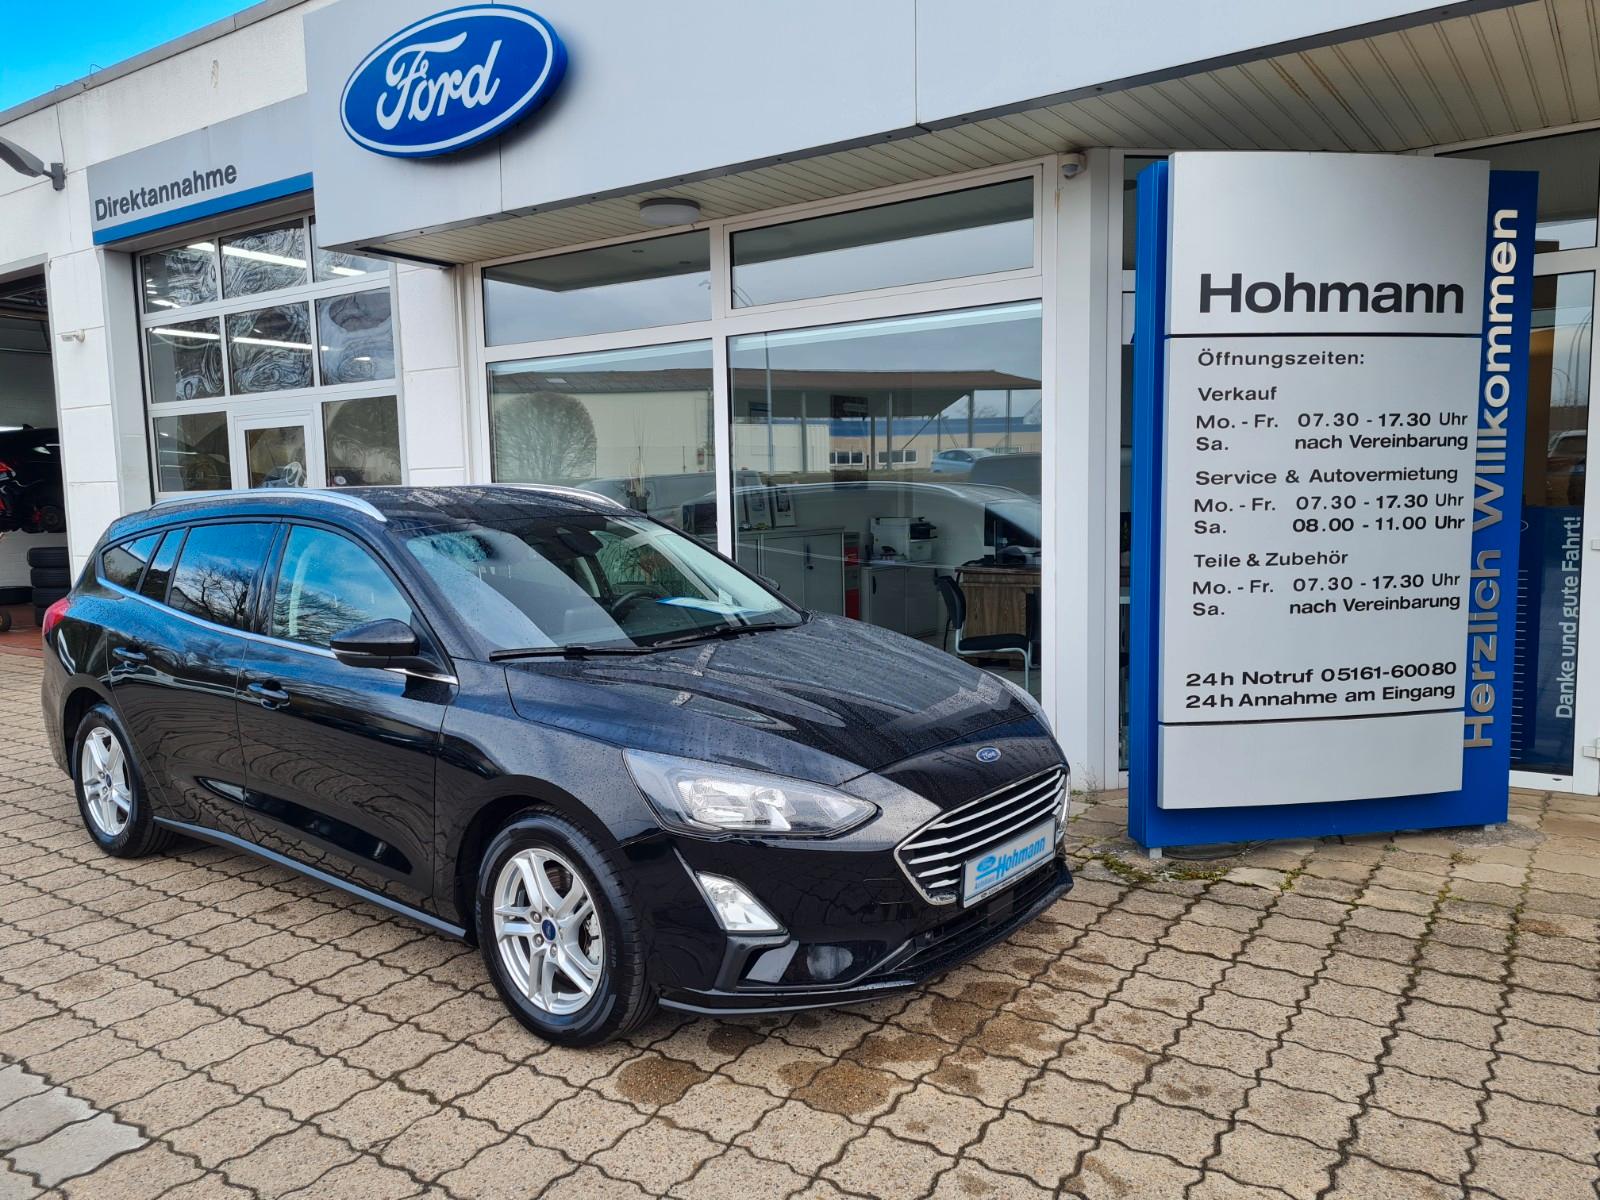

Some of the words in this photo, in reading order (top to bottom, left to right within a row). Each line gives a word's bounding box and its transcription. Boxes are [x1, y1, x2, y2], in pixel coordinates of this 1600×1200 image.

[376, 31, 502, 130] Ford
[95, 164, 237, 221] Direktannahme
[1200, 273, 1464, 314] Hohmann
[1198, 349, 1364, 368] Öffnungszeiten:
[1472, 209, 1518, 532] Willkommen
[1198, 387, 1277, 401] Verkauf
[1197, 415, 1235, 428] Mo.
[1255, 414, 1278, 427] Fr.
[1298, 413, 1358, 427] 07.30
[1379, 413, 1430, 426] 17.30
[1440, 412, 1467, 425] Uhr
[1197, 437, 1228, 451] Sa.
[1296, 435, 1342, 449] nach
[1350, 434, 1468, 450] Vereinbarung
[1196, 471, 1276, 485] Service
[1286, 470, 1299, 483] &
[1310, 467, 1457, 483] Autovermietung
[1195, 499, 1232, 512] Mo.
[1252, 498, 1275, 511] Fr.
[1297, 495, 1356, 510] 07.30
[1377, 494, 1428, 508] 17.30
[1436, 494, 1464, 506] Uhr
[1195, 521, 1226, 534] Sa.
[1293, 518, 1354, 532] 08.00
[1376, 517, 1426, 530] 11.00
[1435, 516, 1465, 529] Uhr
[1561, 516, 1582, 572] Fahrt!
[1194, 554, 1240, 567] Teile
[1247, 554, 1259, 566] &
[1266, 551, 1348, 566] Zubehör
[1193, 582, 1231, 594] Mo.
[1251, 580, 1273, 593] Fr.
[1294, 577, 1352, 591] 07.30
[1373, 575, 1424, 589] 17.30
[1432, 573, 1460, 586] Uhr
[1193, 603, 1224, 616] Sa.
[1290, 600, 1336, 614] nach
[1343, 596, 1460, 611] Vereinbarung
[1561, 576, 1579, 618] gute
[1463, 550, 1501, 748] Herzlich
[1558, 622, 1577, 653] und
[1186, 672, 1233, 686] 24h
[1243, 669, 1313, 684] Notruf
[1321, 662, 1456, 682] 05161-60080
[1186, 694, 1233, 708] 24h
[1239, 692, 1337, 706] Annahme
[1345, 691, 1375, 702] am
[1383, 686, 1455, 701] Eingang
[1556, 659, 1576, 719] Danke
[996, 837, 1046, 880] Hohmann
